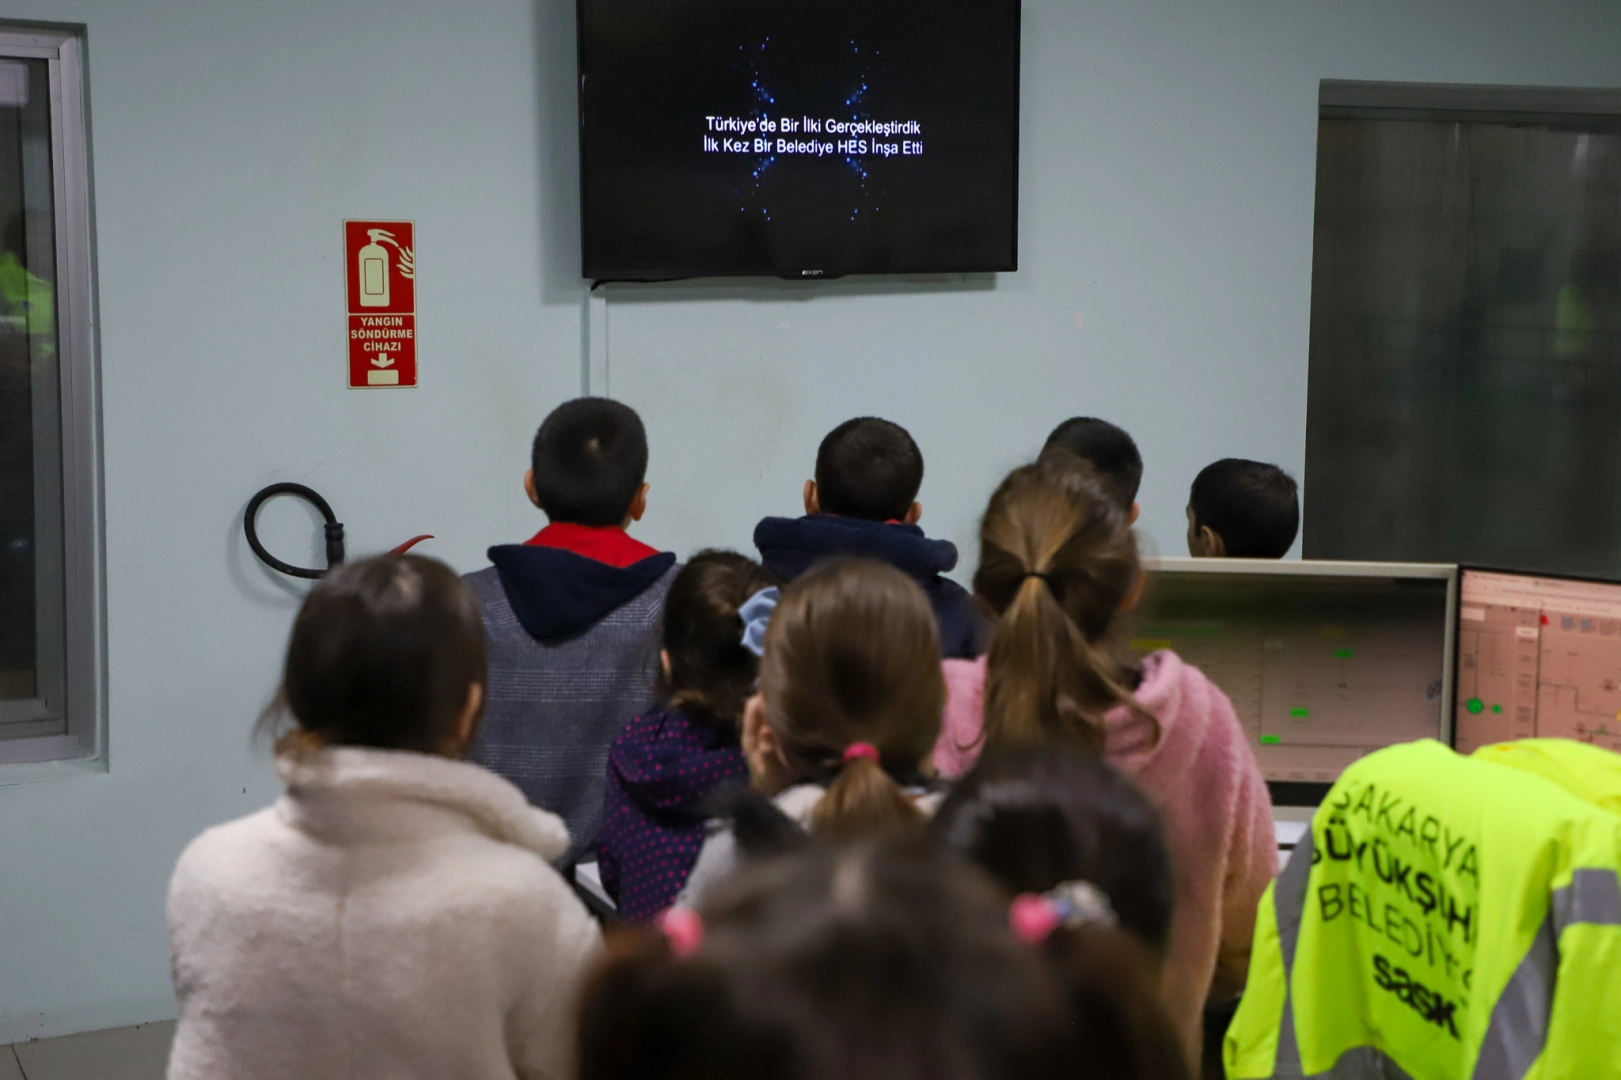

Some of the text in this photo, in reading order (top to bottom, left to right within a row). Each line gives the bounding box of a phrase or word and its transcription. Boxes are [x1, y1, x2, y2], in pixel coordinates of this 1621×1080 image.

[706, 116, 921, 137] Türkiye'de Bir İlki Gerçekleştirdik
[703, 135, 923, 157] İlk Kez Bir Belediye HES İnşa Etti
[361, 317, 403, 326] YANGIN
[351, 327, 413, 339] SÖNDÜRME
[363, 340, 401, 351] CİHAZI
